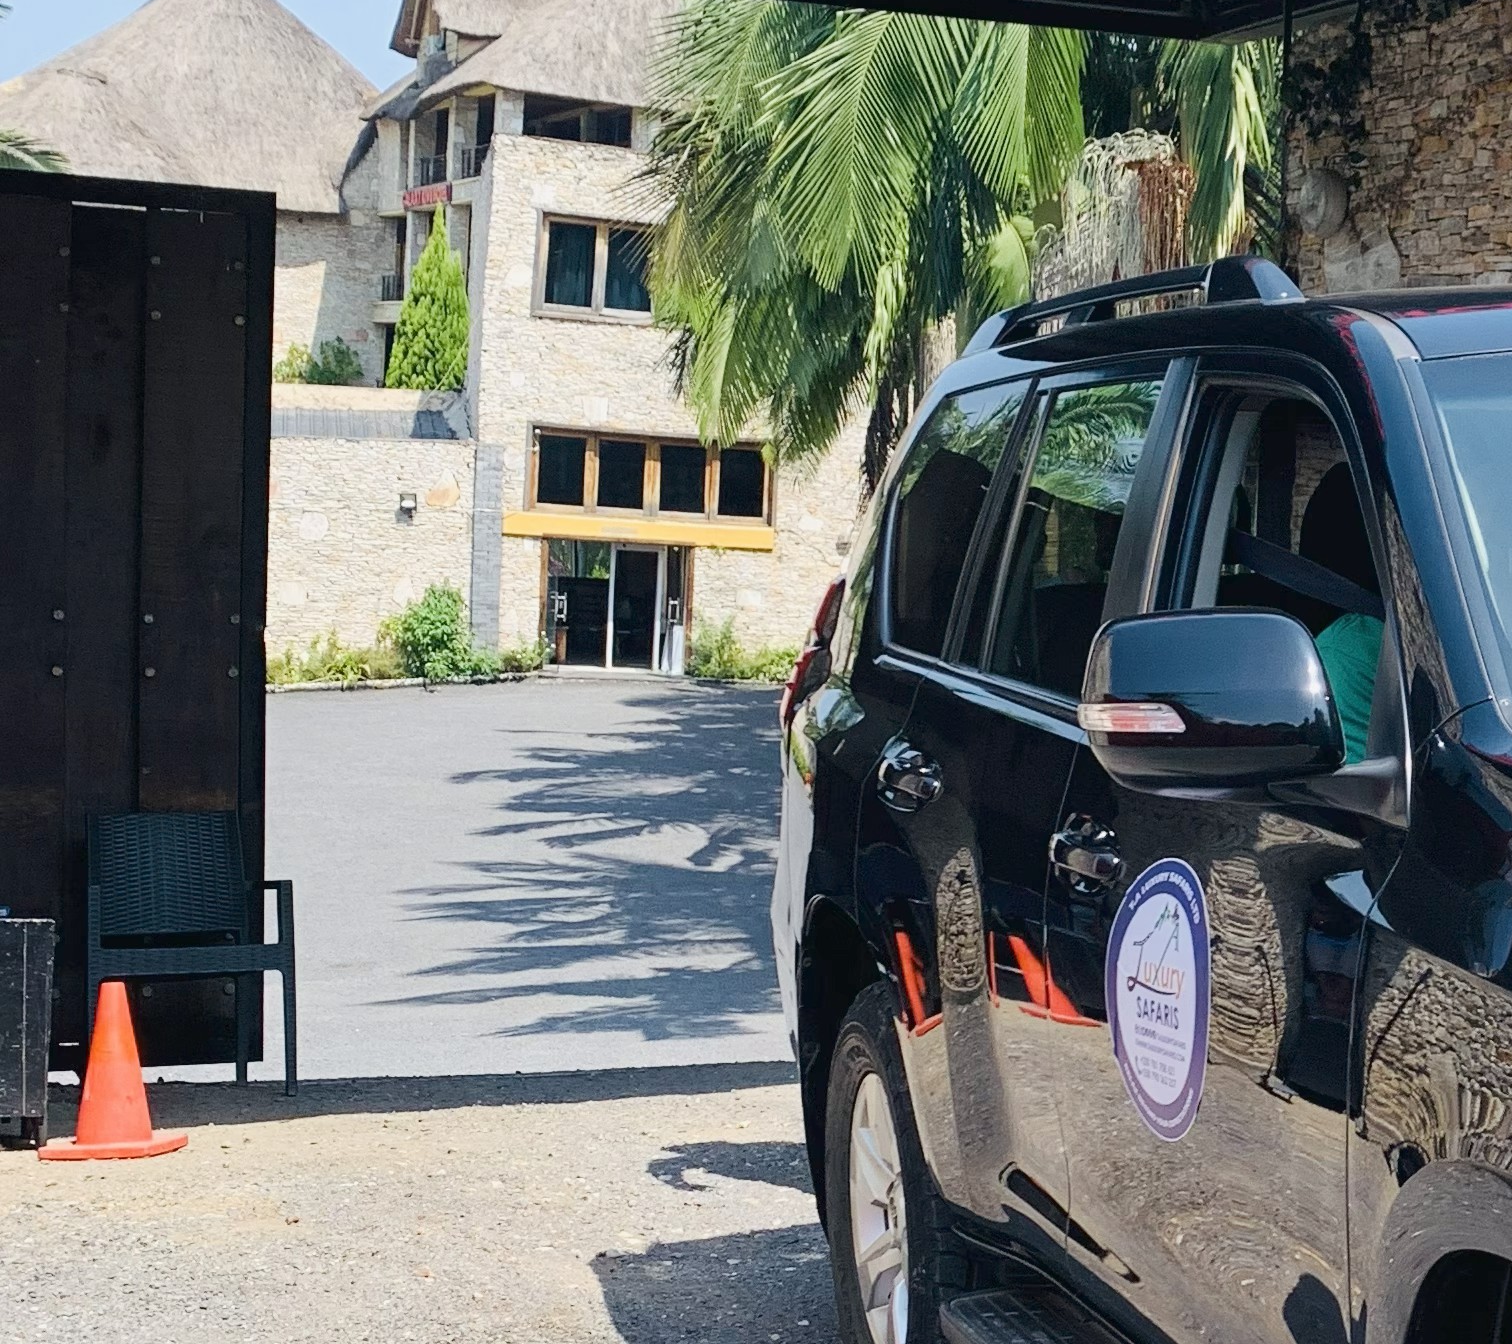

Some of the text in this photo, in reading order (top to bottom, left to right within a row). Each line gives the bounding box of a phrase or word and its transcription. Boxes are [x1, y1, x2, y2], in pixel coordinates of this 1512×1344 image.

[1168, 871, 1195, 902] SAFARIS
[1190, 898, 1201, 924] LTD
[1127, 946, 1185, 1000] Luxury
[1136, 995, 1180, 1030] SAFARIS
